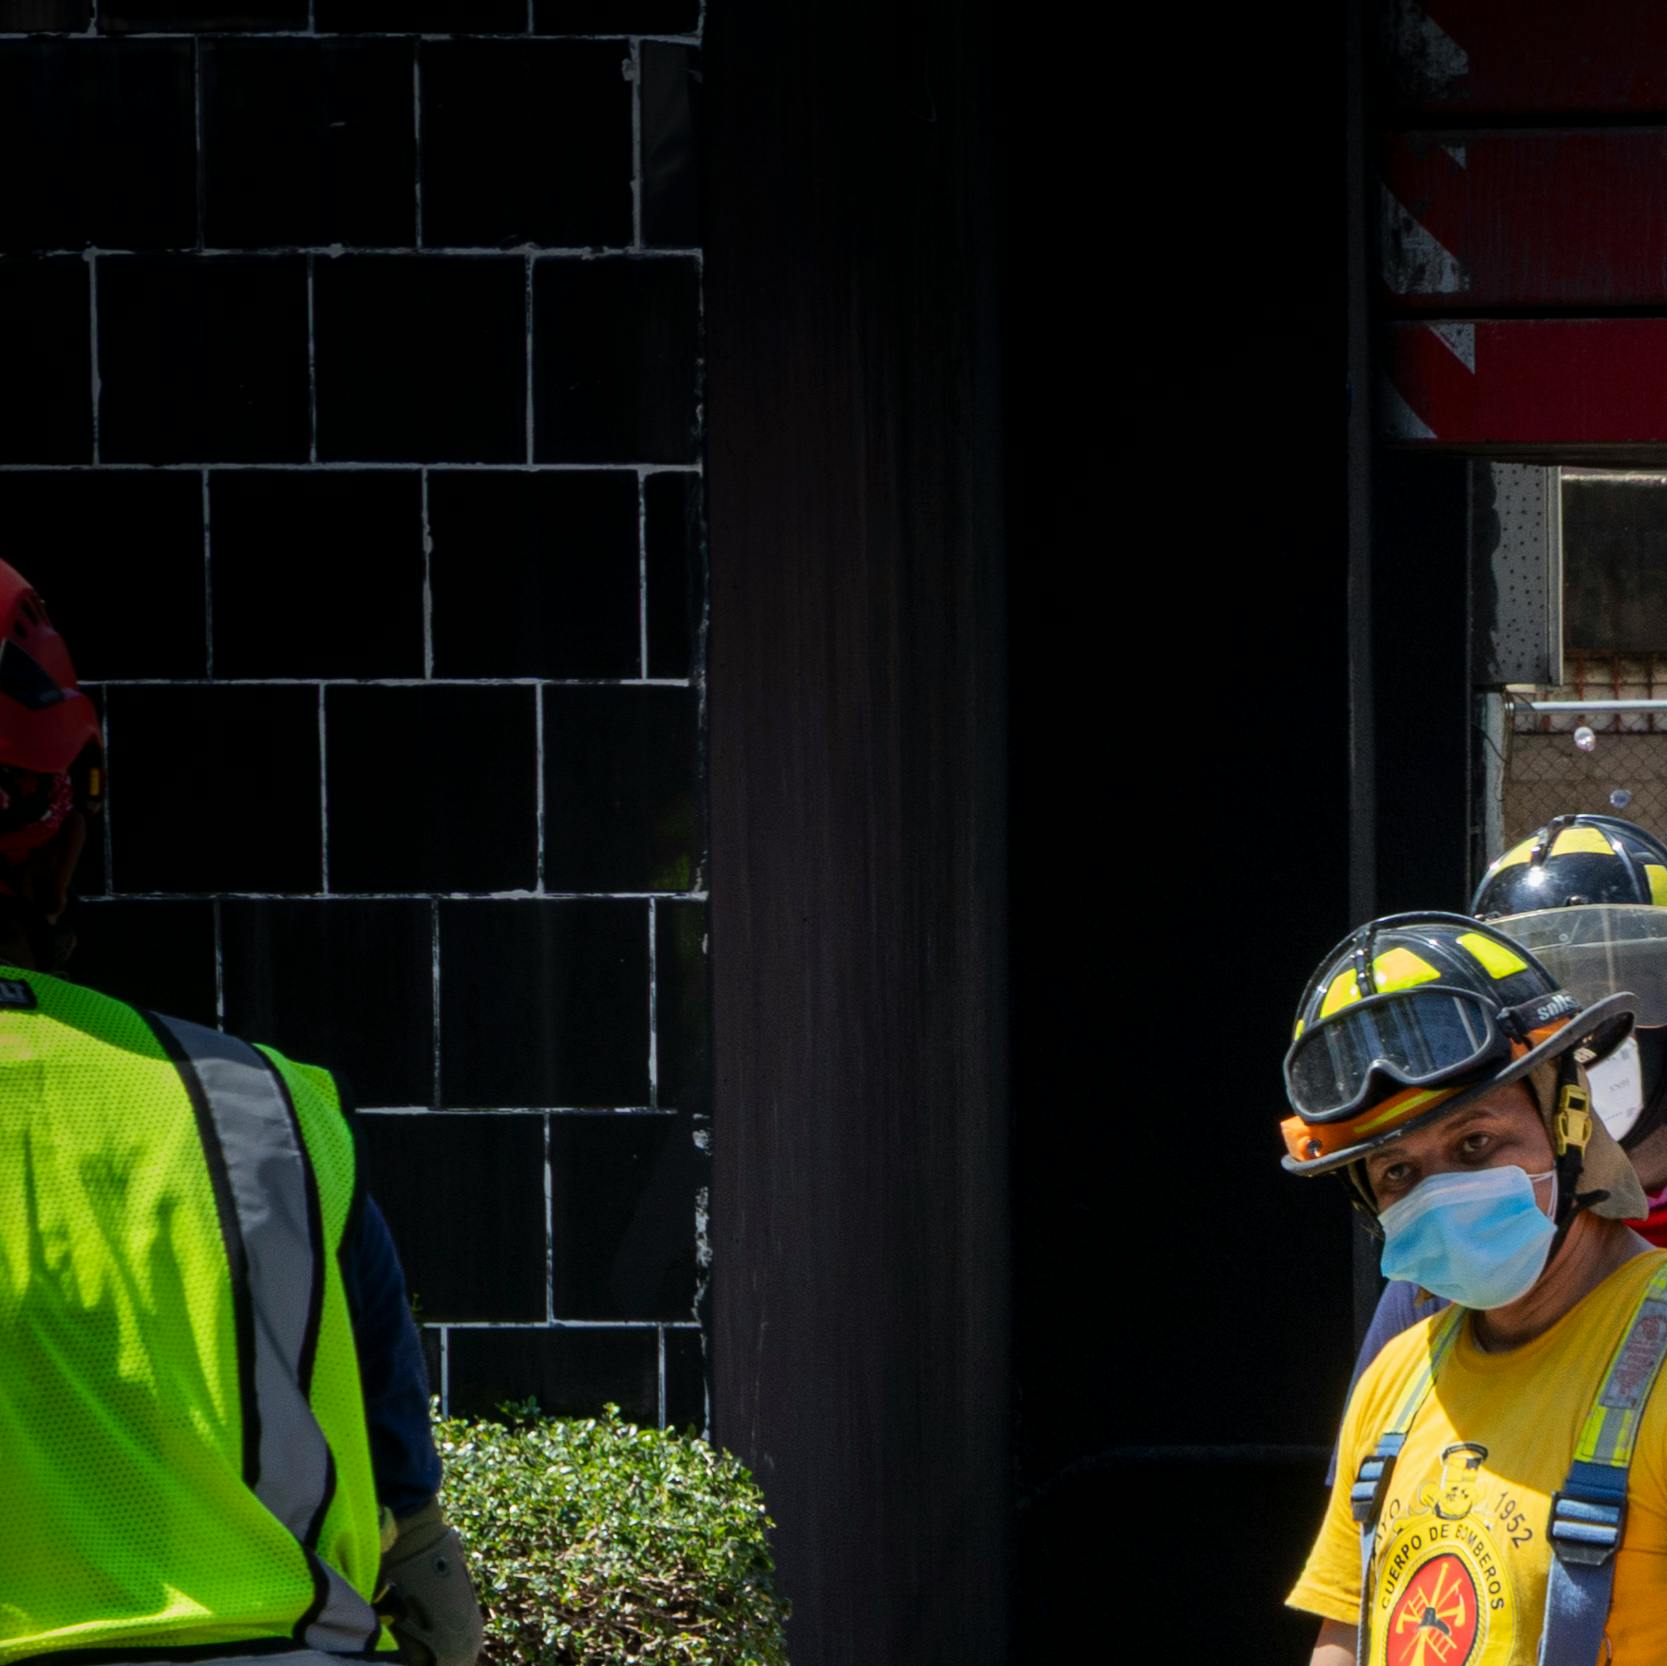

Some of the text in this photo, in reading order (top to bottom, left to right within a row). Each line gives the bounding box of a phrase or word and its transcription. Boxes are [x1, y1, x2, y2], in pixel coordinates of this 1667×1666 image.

[1494, 1491, 1533, 1548] 1952
[1382, 1523, 1505, 1611] CUERPO DE BOMBEROS
